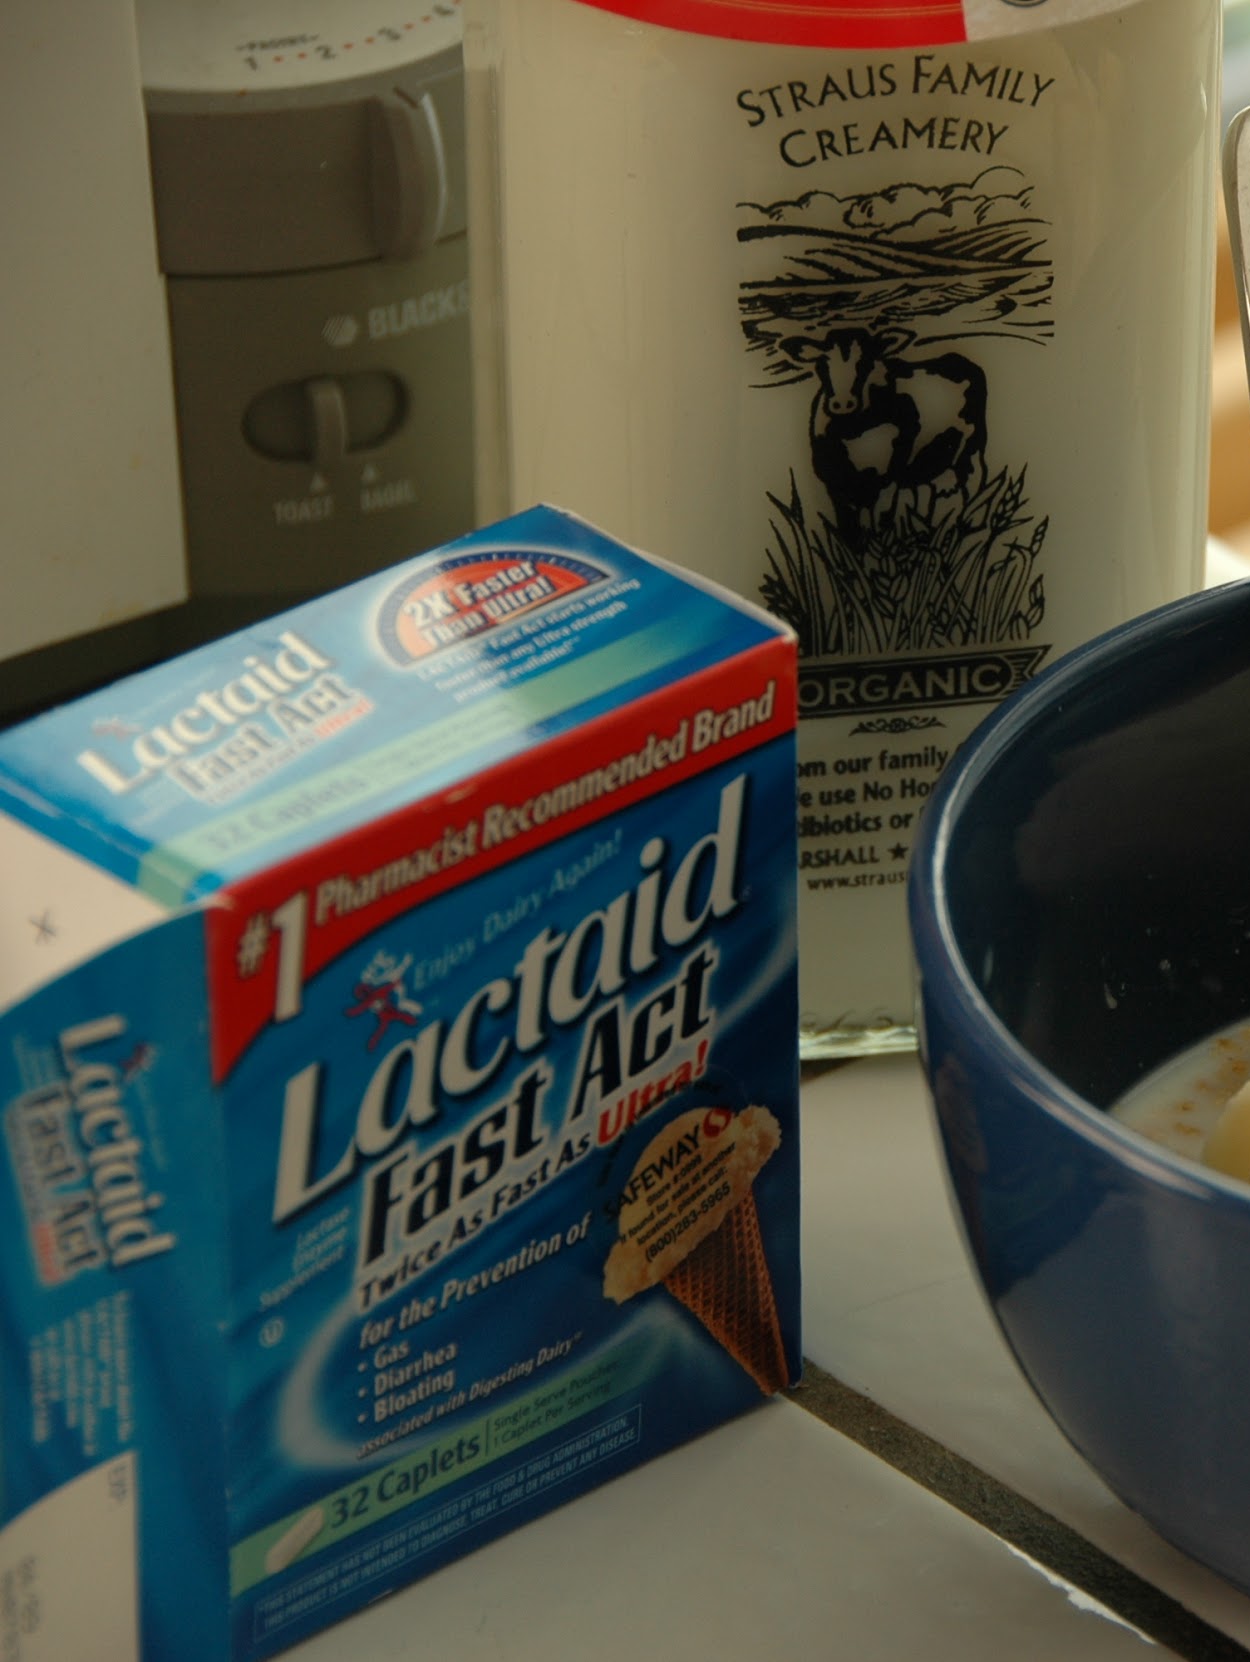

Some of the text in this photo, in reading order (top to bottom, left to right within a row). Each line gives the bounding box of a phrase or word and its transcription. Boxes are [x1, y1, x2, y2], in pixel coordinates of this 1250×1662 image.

[737, 54, 1055, 127] STRAUS FAMILY
[779, 117, 1009, 168] CREAMERY
[404, 560, 538, 626] 2X Faster
[422, 575, 555, 647] Than Ultra!
[586, 579, 641, 608] working
[76, 630, 332, 794] Lactaid
[798, 664, 1003, 708] ORGANIC
[176, 725, 274, 793] Fast
[276, 675, 351, 734] Act
[797, 745, 949, 777] om our family
[819, 788, 857, 806] use
[863, 780, 893, 802] No
[236, 888, 307, 1022] #1
[315, 820, 478, 926] Pharmacist
[481, 720, 689, 849] Recommended
[692, 680, 776, 753] Brand
[797, 811, 883, 838] ibiotics
[889, 813, 913, 830] or
[798, 845, 881, 870] RSHALL
[806, 870, 908, 890] www.straus
[413, 828, 622, 992] Enjoy Dairy Again!
[271, 774, 747, 1224] Lactaid
[365, 1066, 547, 1268] Fast
[568, 945, 718, 1122] Act
[60, 1013, 176, 1266] Lactaid
[362, 1240, 441, 1308] Twice
[448, 1209, 483, 1248] As
[491, 1157, 552, 1218] Fast
[555, 1133, 591, 1173] As
[598, 1039, 709, 1145] Ultra!
[603, 1124, 700, 1224] SAFEWAY
[628, 1211, 655, 1238] found
[655, 1199, 669, 1214] for
[671, 1182, 690, 1202] sale
[702, 1141, 736, 1176] another
[646, 1182, 672, 1206] Store
[677, 1184, 708, 1215] please
[359, 1209, 593, 1349] for the Prevention of
[373, 1340, 410, 1370] Gas
[373, 1343, 458, 1398] Diarrhea
[356, 1408, 434, 1460] associated
[436, 1389, 466, 1418] with
[469, 1360, 534, 1402] Digesting
[373, 1367, 457, 1423] Bloating
[493, 1404, 530, 1432] Single
[535, 1388, 567, 1409] Serve
[501, 1416, 543, 1444] Caplet
[331, 1433, 481, 1529] 32 Caplets
[492, 1475, 516, 1495] FOOD
[527, 1456, 551, 1478] DRUG
[539, 1461, 578, 1489] PREVENT
[579, 1448, 599, 1468] ANY
